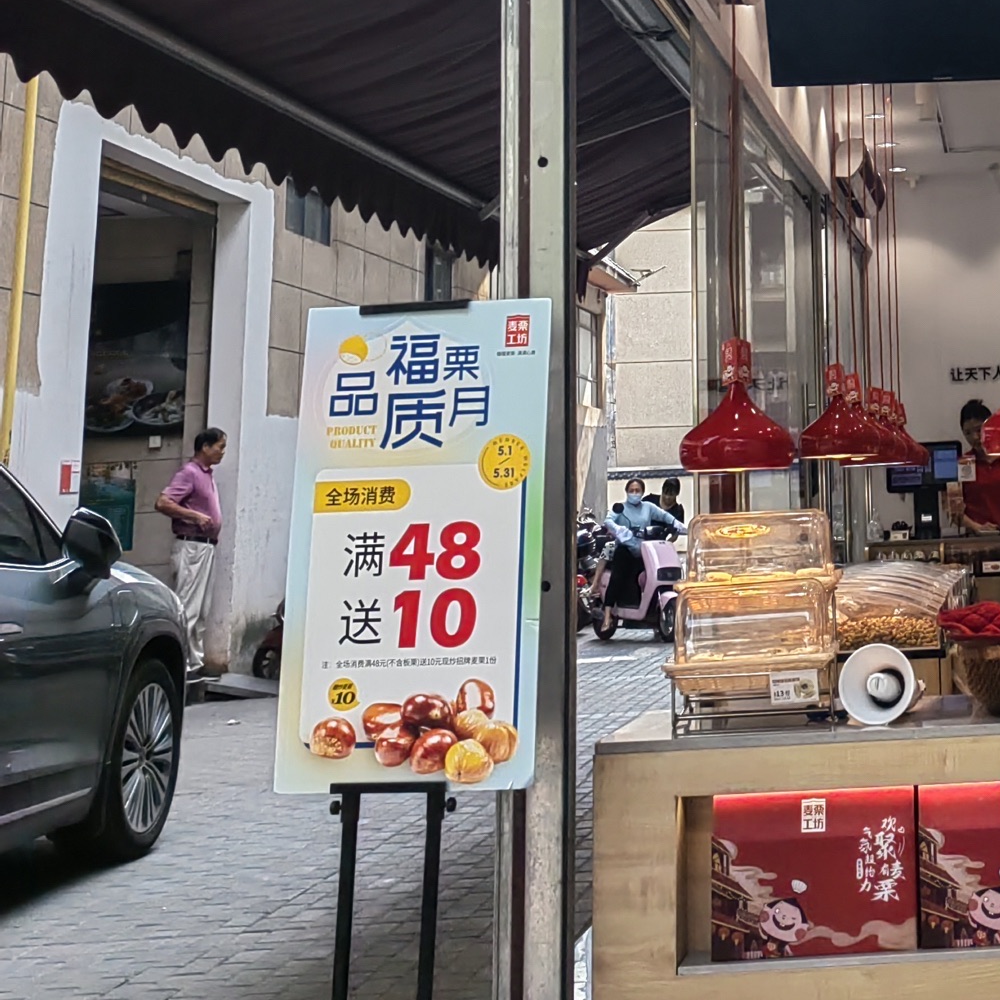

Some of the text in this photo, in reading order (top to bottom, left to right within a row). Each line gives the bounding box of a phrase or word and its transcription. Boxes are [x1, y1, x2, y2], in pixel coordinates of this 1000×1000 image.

[506, 333, 527, 345] 工坊
[326, 424, 378, 437] PRODUCT
[329, 437, 377, 449] QUALITY
[497, 445, 512, 456] 5.1
[493, 467, 515, 478] 5.31
[325, 486, 396, 506] 全场消费
[343, 521, 481, 581] 满48
[338, 588, 477, 648] 送10
[803, 818, 824, 830] 工坊
